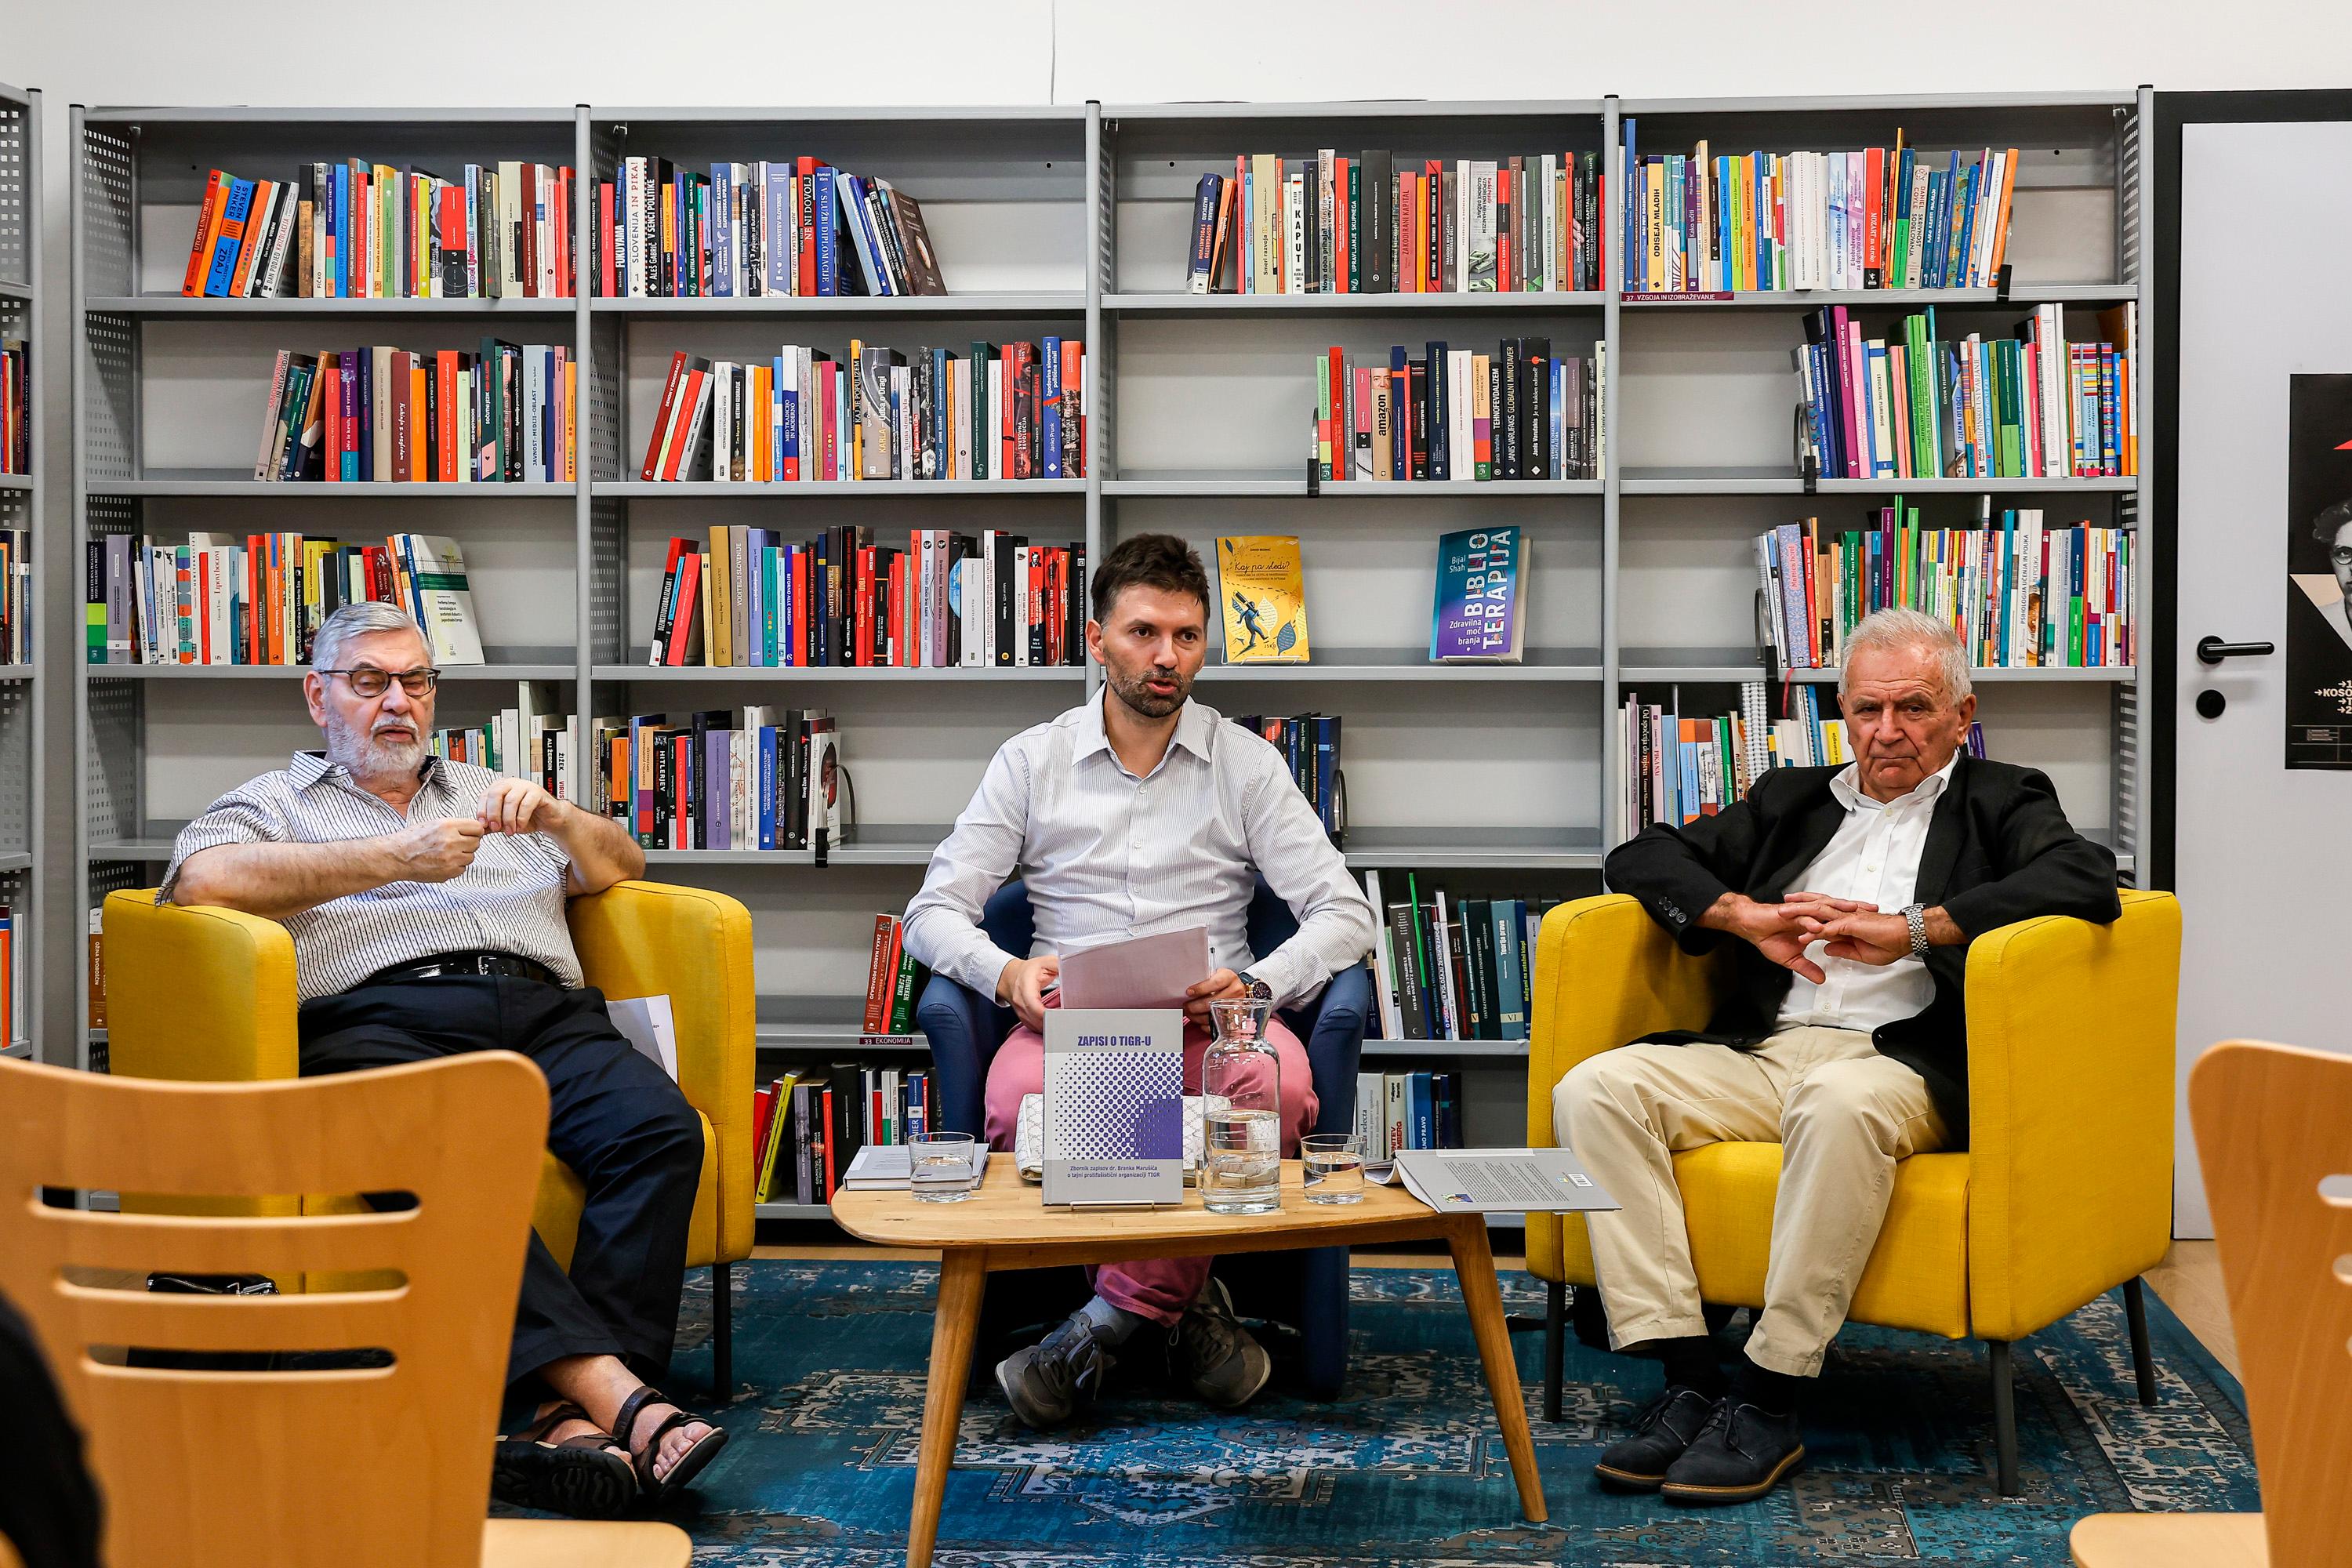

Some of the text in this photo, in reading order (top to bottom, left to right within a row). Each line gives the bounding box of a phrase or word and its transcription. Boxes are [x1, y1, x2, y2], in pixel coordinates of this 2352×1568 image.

[198, 197, 211, 227] UNIFORME
[228, 185, 241, 217] PINKER
[236, 187, 249, 219] STEVEN
[632, 196, 637, 207] IN
[805, 214, 811, 226] NI
[194, 228, 205, 250] UTOPIJA
[269, 252, 281, 272] PODJED
[275, 218, 289, 251] KRIZOLACIJA
[615, 225, 625, 267] FUKUYAMA
[804, 227, 811, 240] NE
[1909, 213, 1918, 256] SODELOVANJA
[468, 231, 477, 265] ljubezni
[648, 242, 657, 263] GABRIČ
[215, 248, 227, 274] ZDAJ
[277, 354, 289, 391] NELAGODJA
[855, 401, 860, 409] JE
[1377, 394, 1386, 436] amazon
[1235, 561, 1290, 574] Kaj pa sledi?
[1450, 564, 1465, 573] Shah
[1452, 555, 1466, 564] Bijal
[1465, 533, 1488, 617] BIBLIO
[1483, 530, 1512, 649] TERAPIJA
[1450, 619, 1482, 629] Zdravilna
[1457, 637, 1480, 645] branja
[903, 975, 912, 1000] HEINEKEN
[1078, 1036, 1151, 1046] ZAPISI O TIGR-U
